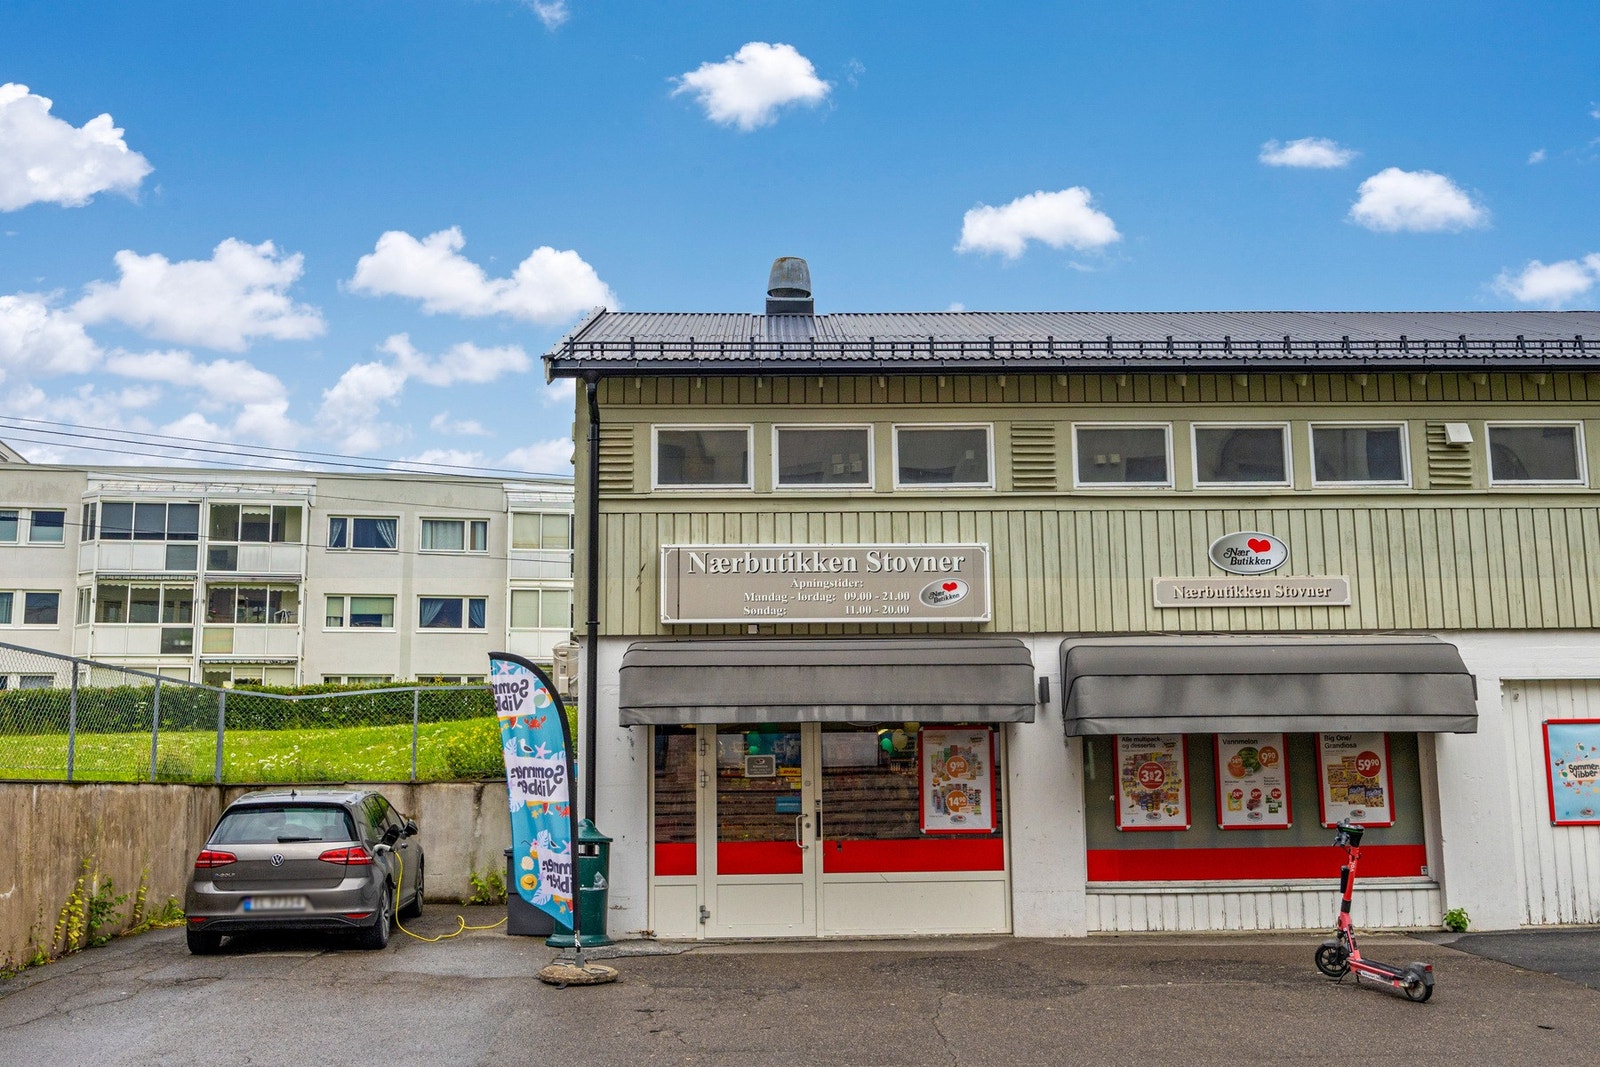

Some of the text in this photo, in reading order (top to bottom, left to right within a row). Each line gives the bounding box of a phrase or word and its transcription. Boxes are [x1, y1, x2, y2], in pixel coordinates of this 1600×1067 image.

[1223, 547, 1250, 558] Nær
[688, 550, 966, 574] Nærbutikken Stovner
[1230, 557, 1272, 566] Butikken
[1172, 584, 1332, 599] Nærbutikken Stovner
[743, 592, 788, 604] Mandag
[844, 591, 873, 602] 09.00
[882, 591, 911, 602] 21.00
[845, 604, 873, 615] 11.00
[882, 604, 911, 615] 20.00
[1323, 734, 1335, 742] Big
